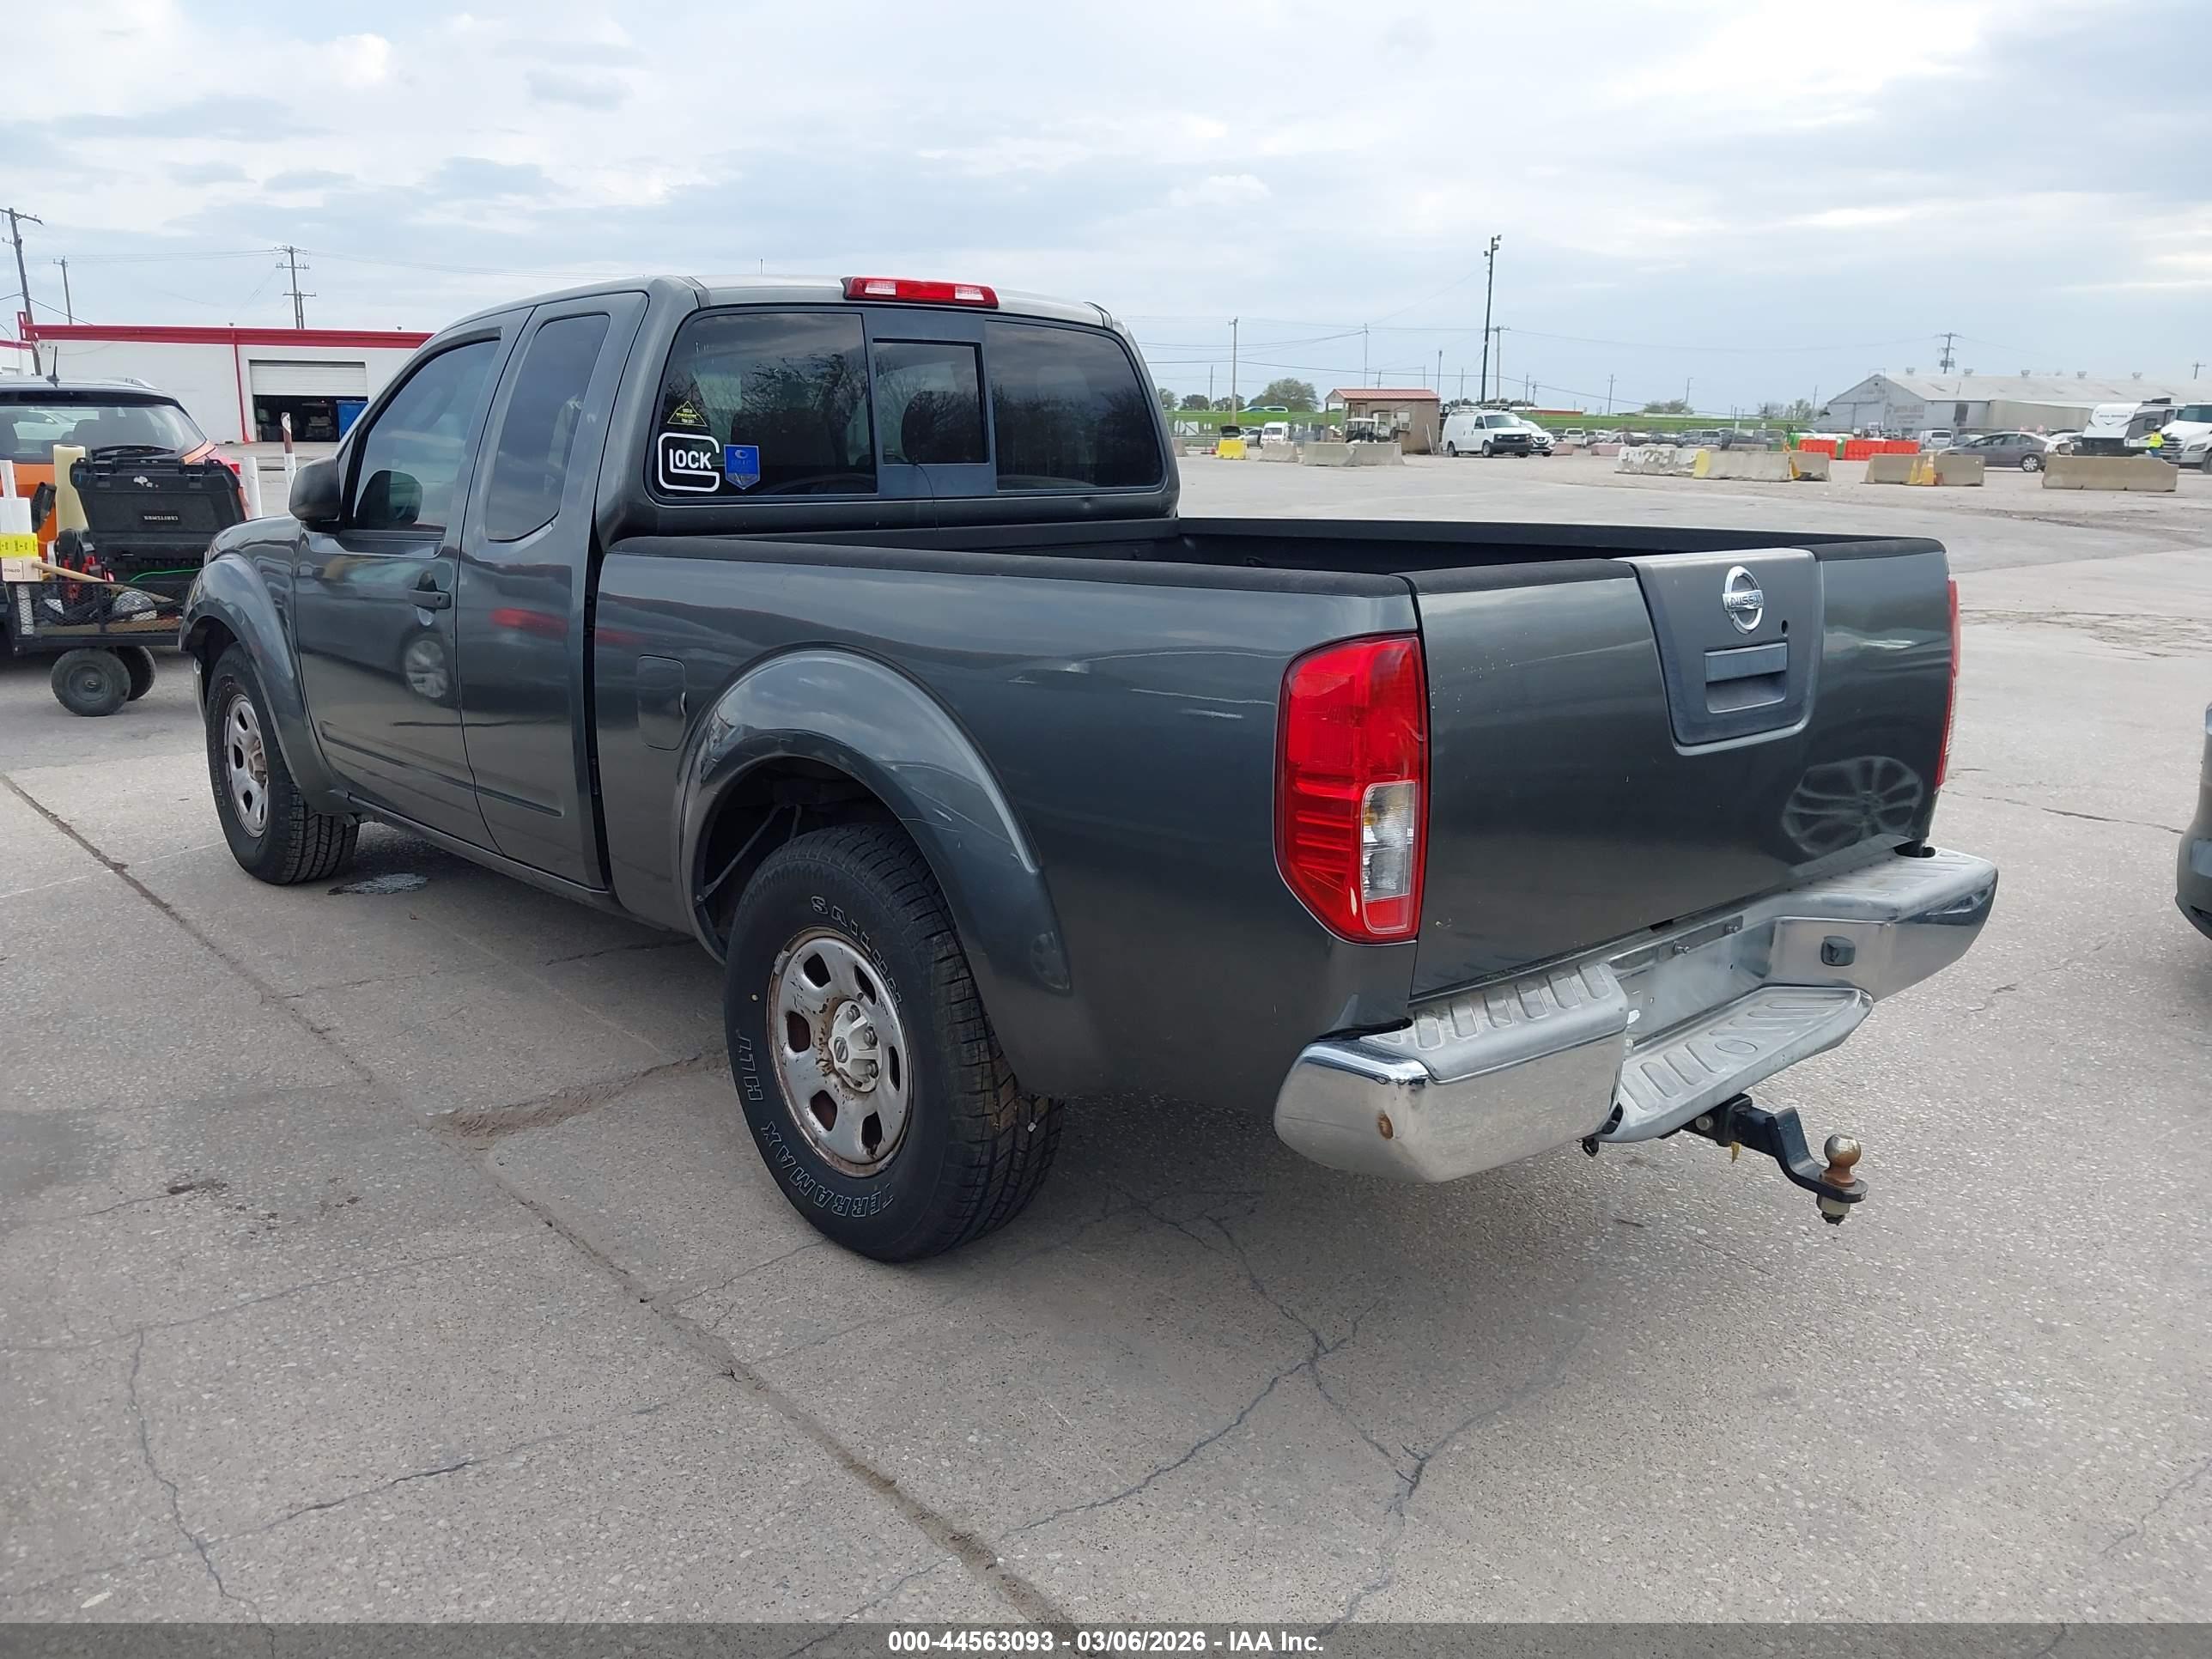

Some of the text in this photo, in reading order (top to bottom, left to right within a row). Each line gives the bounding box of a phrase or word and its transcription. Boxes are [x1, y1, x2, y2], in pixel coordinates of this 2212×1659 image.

[1726, 592, 1763, 608] NISSAN
[811, 895, 902, 1004] SAILUN
[761, 1120, 894, 1218] TERRAMAX
